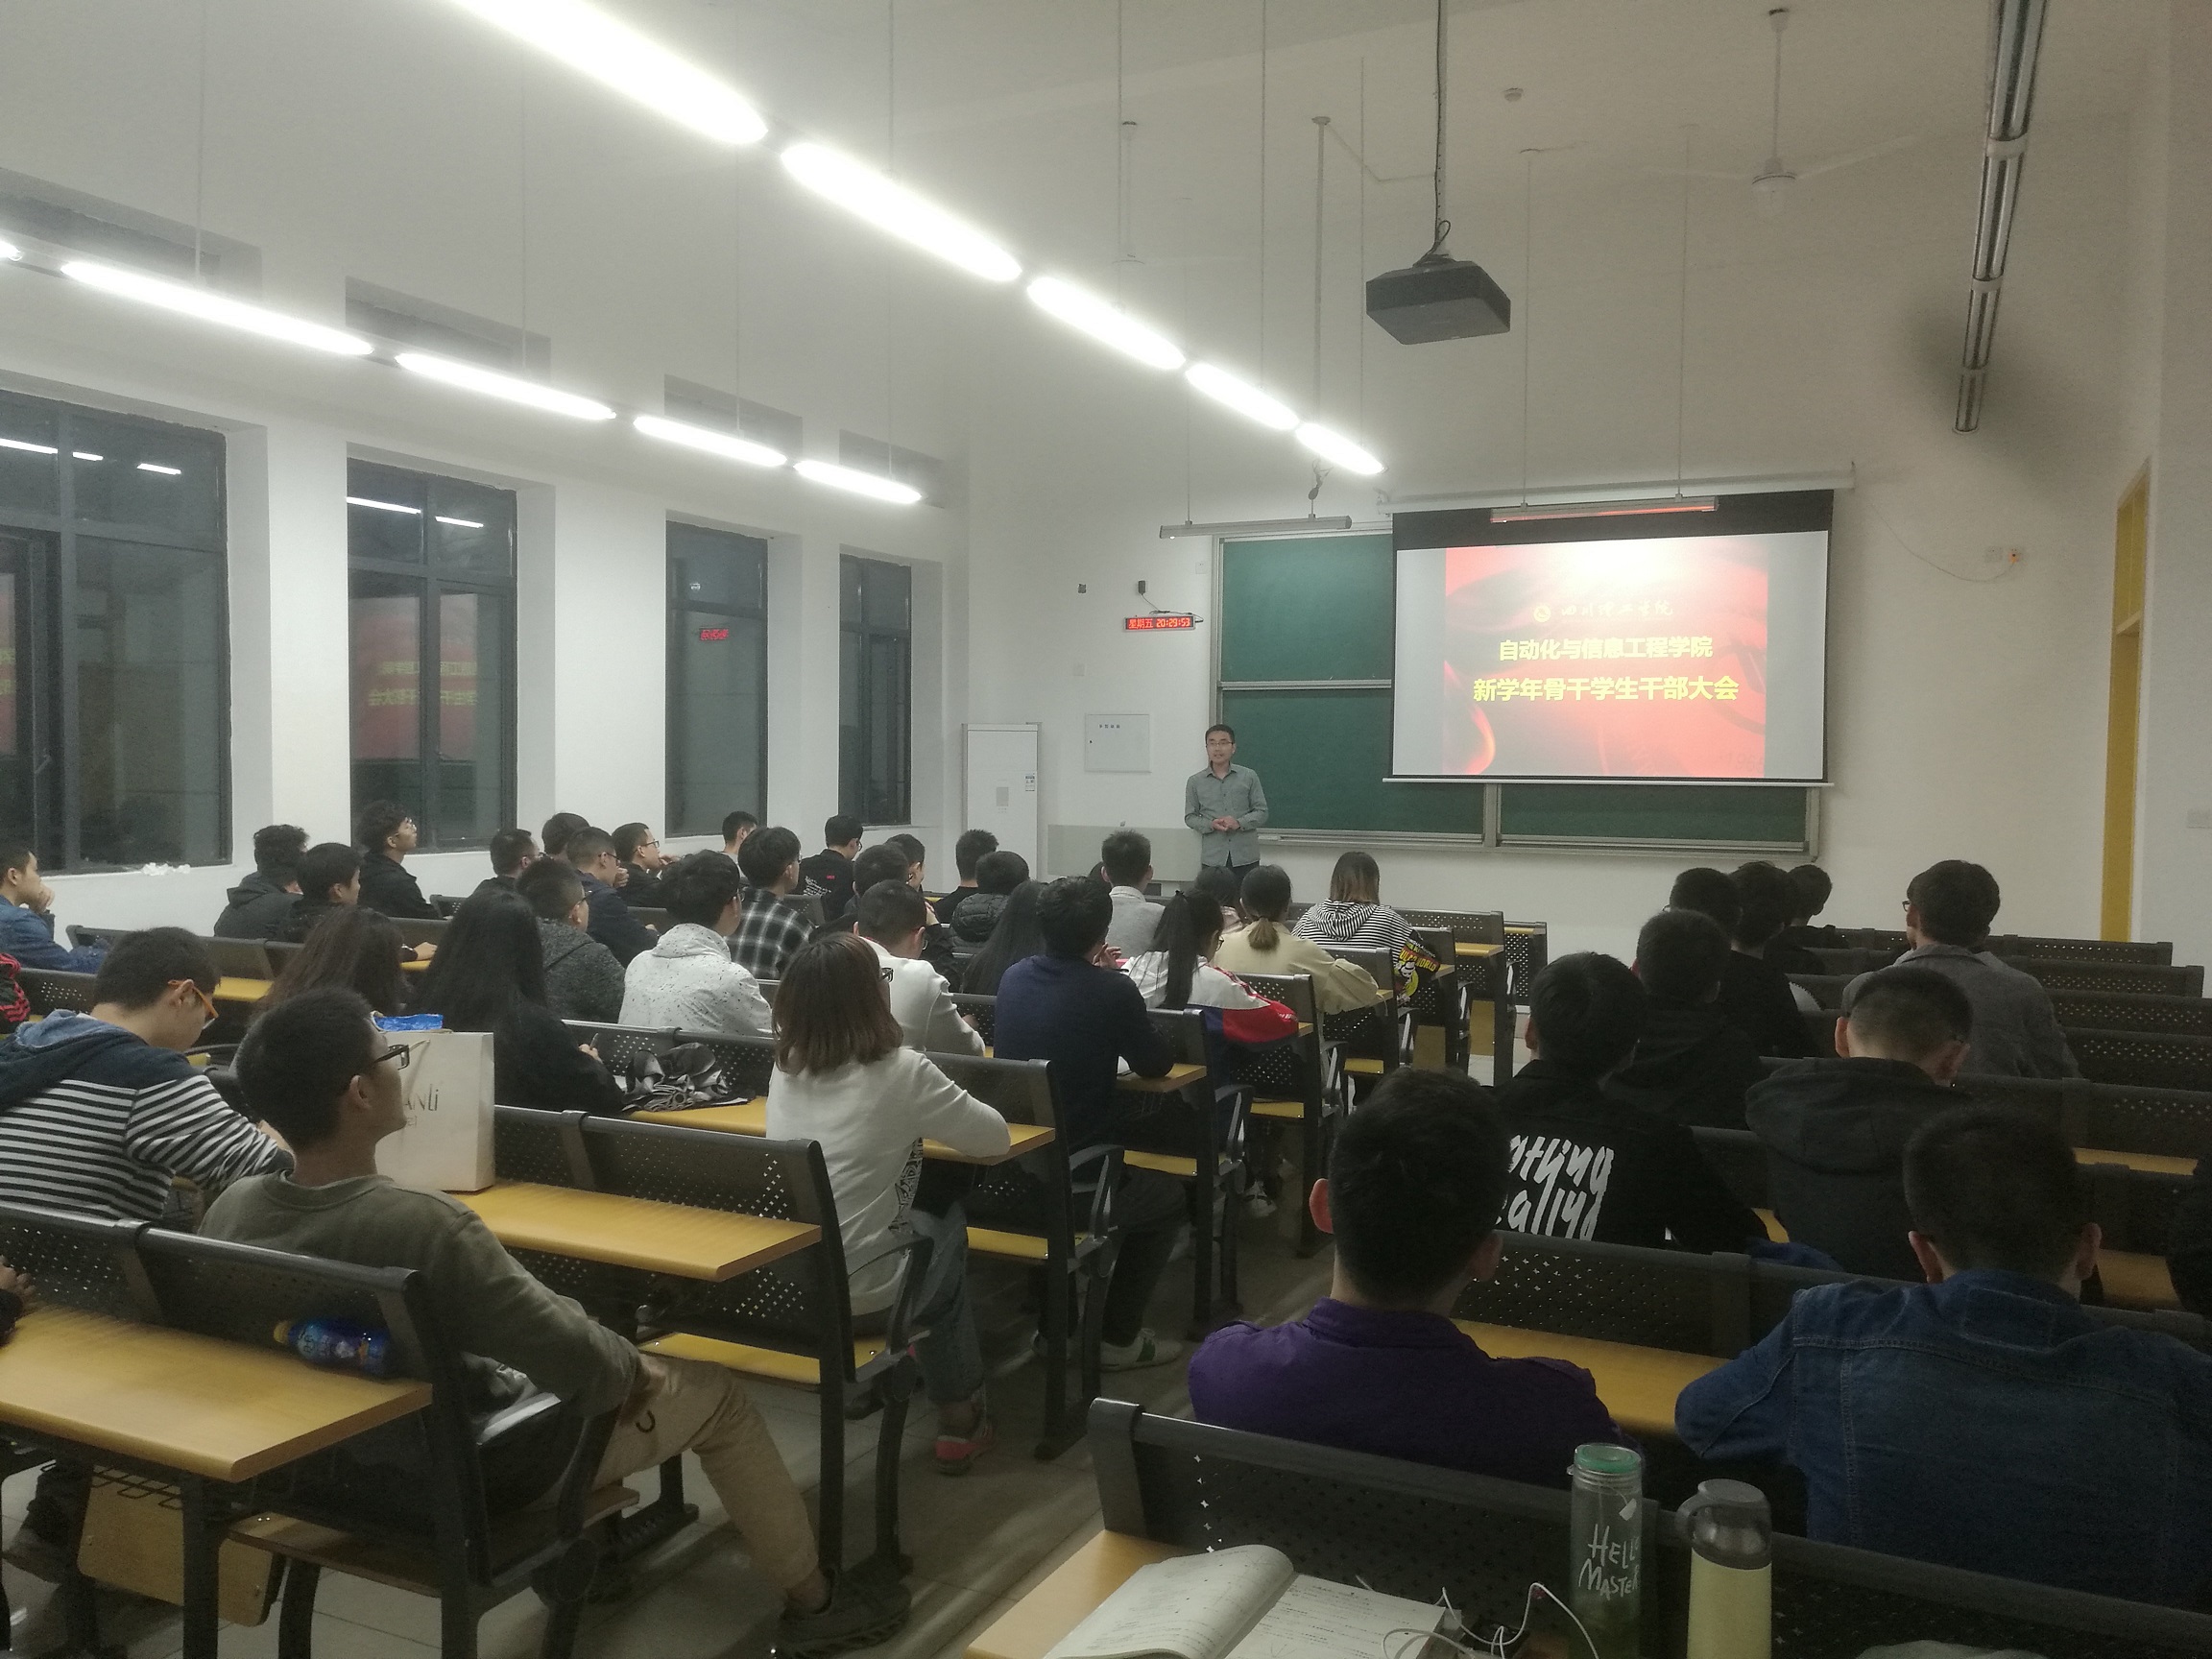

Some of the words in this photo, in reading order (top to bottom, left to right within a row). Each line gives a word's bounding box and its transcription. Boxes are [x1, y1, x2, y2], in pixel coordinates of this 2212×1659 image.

[1128, 618, 1153, 629] 星期五
[1156, 617, 1190, 628] 20:29:53
[1499, 636, 1714, 661] 自动化与信息工程学院
[1473, 675, 1740, 702] 新学年骨干学生干部大会
